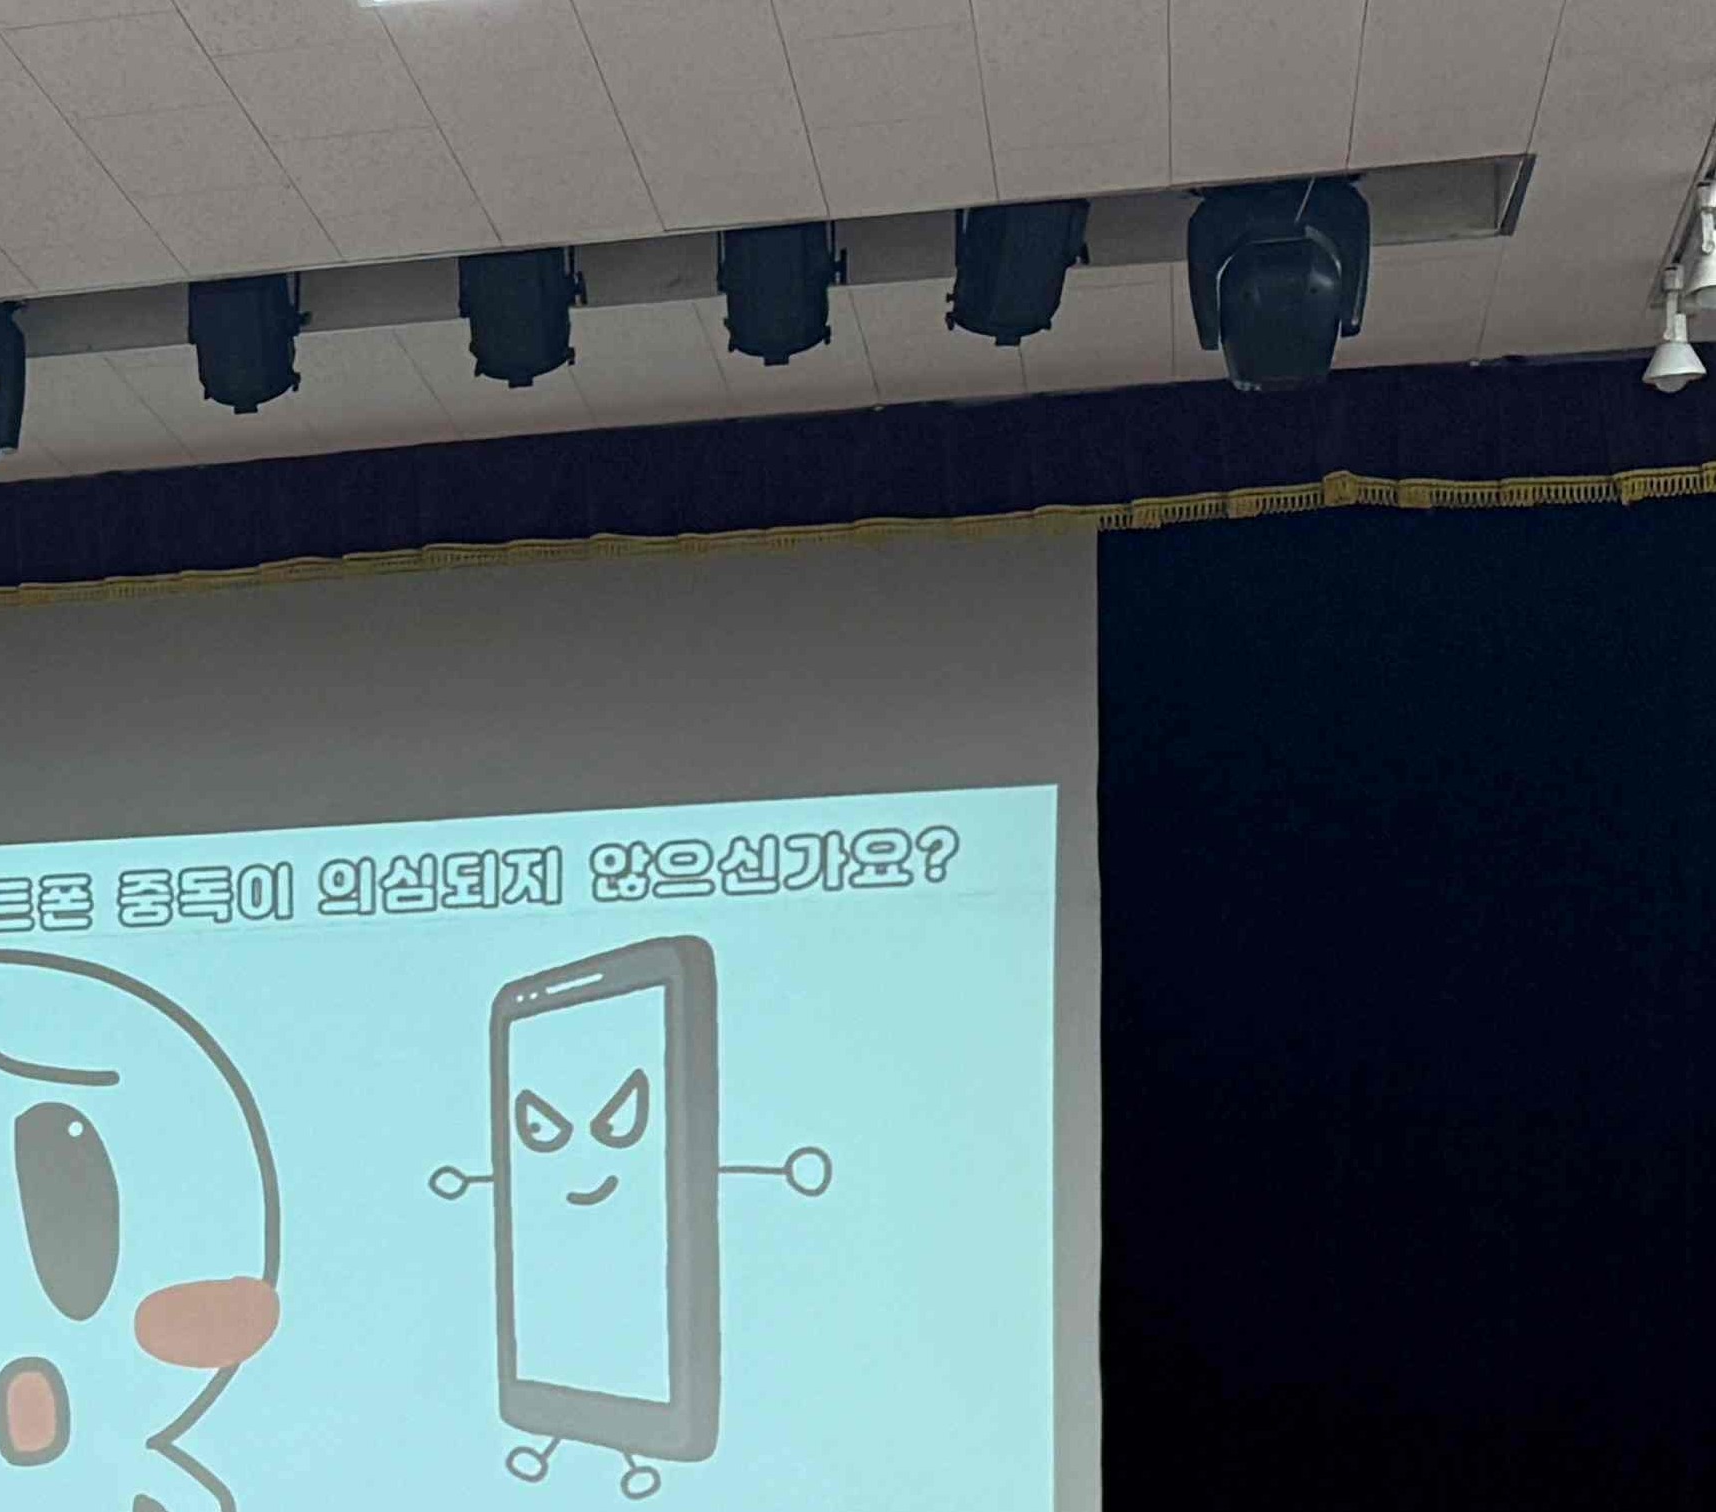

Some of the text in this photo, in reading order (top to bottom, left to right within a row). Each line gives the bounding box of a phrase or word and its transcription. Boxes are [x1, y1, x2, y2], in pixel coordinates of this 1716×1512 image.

[116, 861, 294, 928] 중독이
[317, 845, 563, 916] 의심되지
[589, 825, 960, 903] 않으신가요?
